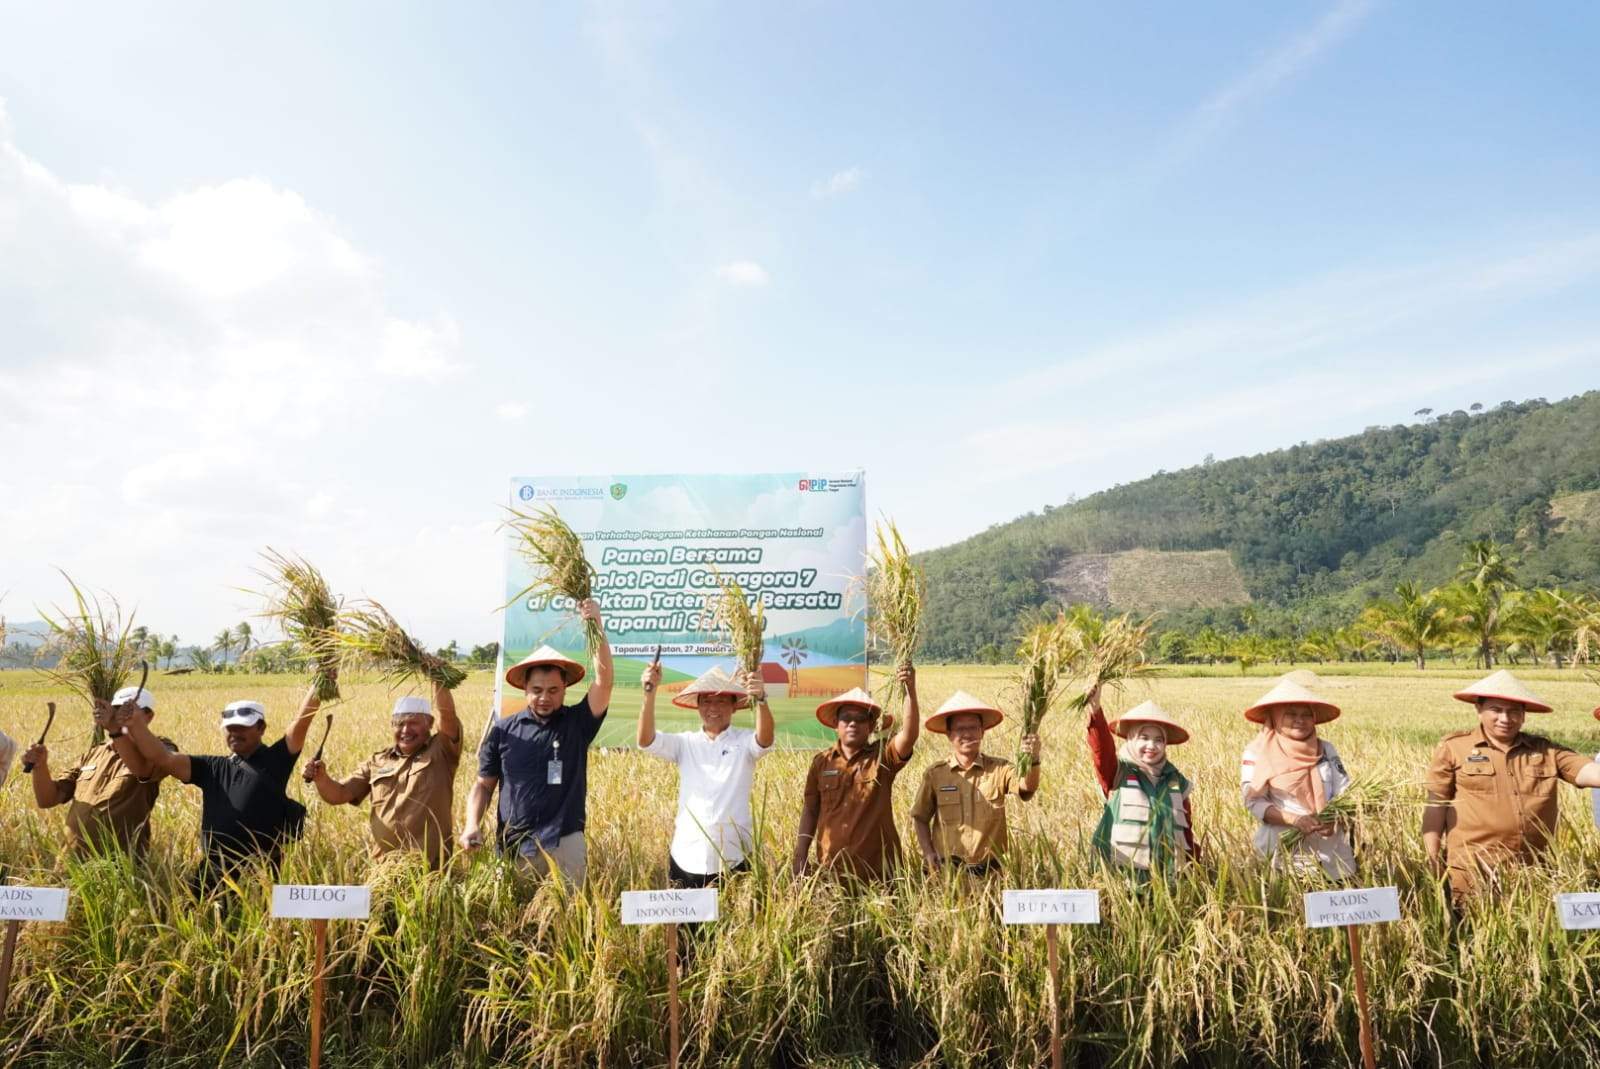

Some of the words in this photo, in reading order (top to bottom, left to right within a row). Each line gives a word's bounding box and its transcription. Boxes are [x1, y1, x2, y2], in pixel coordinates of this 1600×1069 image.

[560, 487, 604, 496] INDONESIA
[595, 530, 641, 541] Terhadap
[641, 530, 684, 541] Program
[684, 529, 738, 538] Ketahanan
[739, 529, 778, 540] Pangan
[779, 527, 824, 537] Nasional
[602, 547, 668, 565] Panen
[669, 546, 762, 564] Bersama
[639, 568, 687, 589] Padi
[689, 569, 798, 590] Gamagora
[800, 568, 817, 588] 7
[527, 594, 547, 611] di
[549, 591, 648, 613] Gaktan
[759, 591, 842, 609] Bersatu
[602, 612, 687, 634] Tapanuli
[614, 645, 649, 654] Tapanuli
[685, 645, 693, 653] 27
[695, 645, 727, 653] Januari
[0, 890, 33, 901] ADIS
[289, 887, 346, 902] BULOG
[650, 892, 683, 902] BANK
[1329, 894, 1369, 907] KADIS
[0, 906, 44, 916] KANAN
[636, 907, 696, 918] INDONESIA
[1017, 902, 1076, 913] BUPATI
[1572, 903, 1600, 916] KAT
[1319, 910, 1381, 924] PERTANIAN
